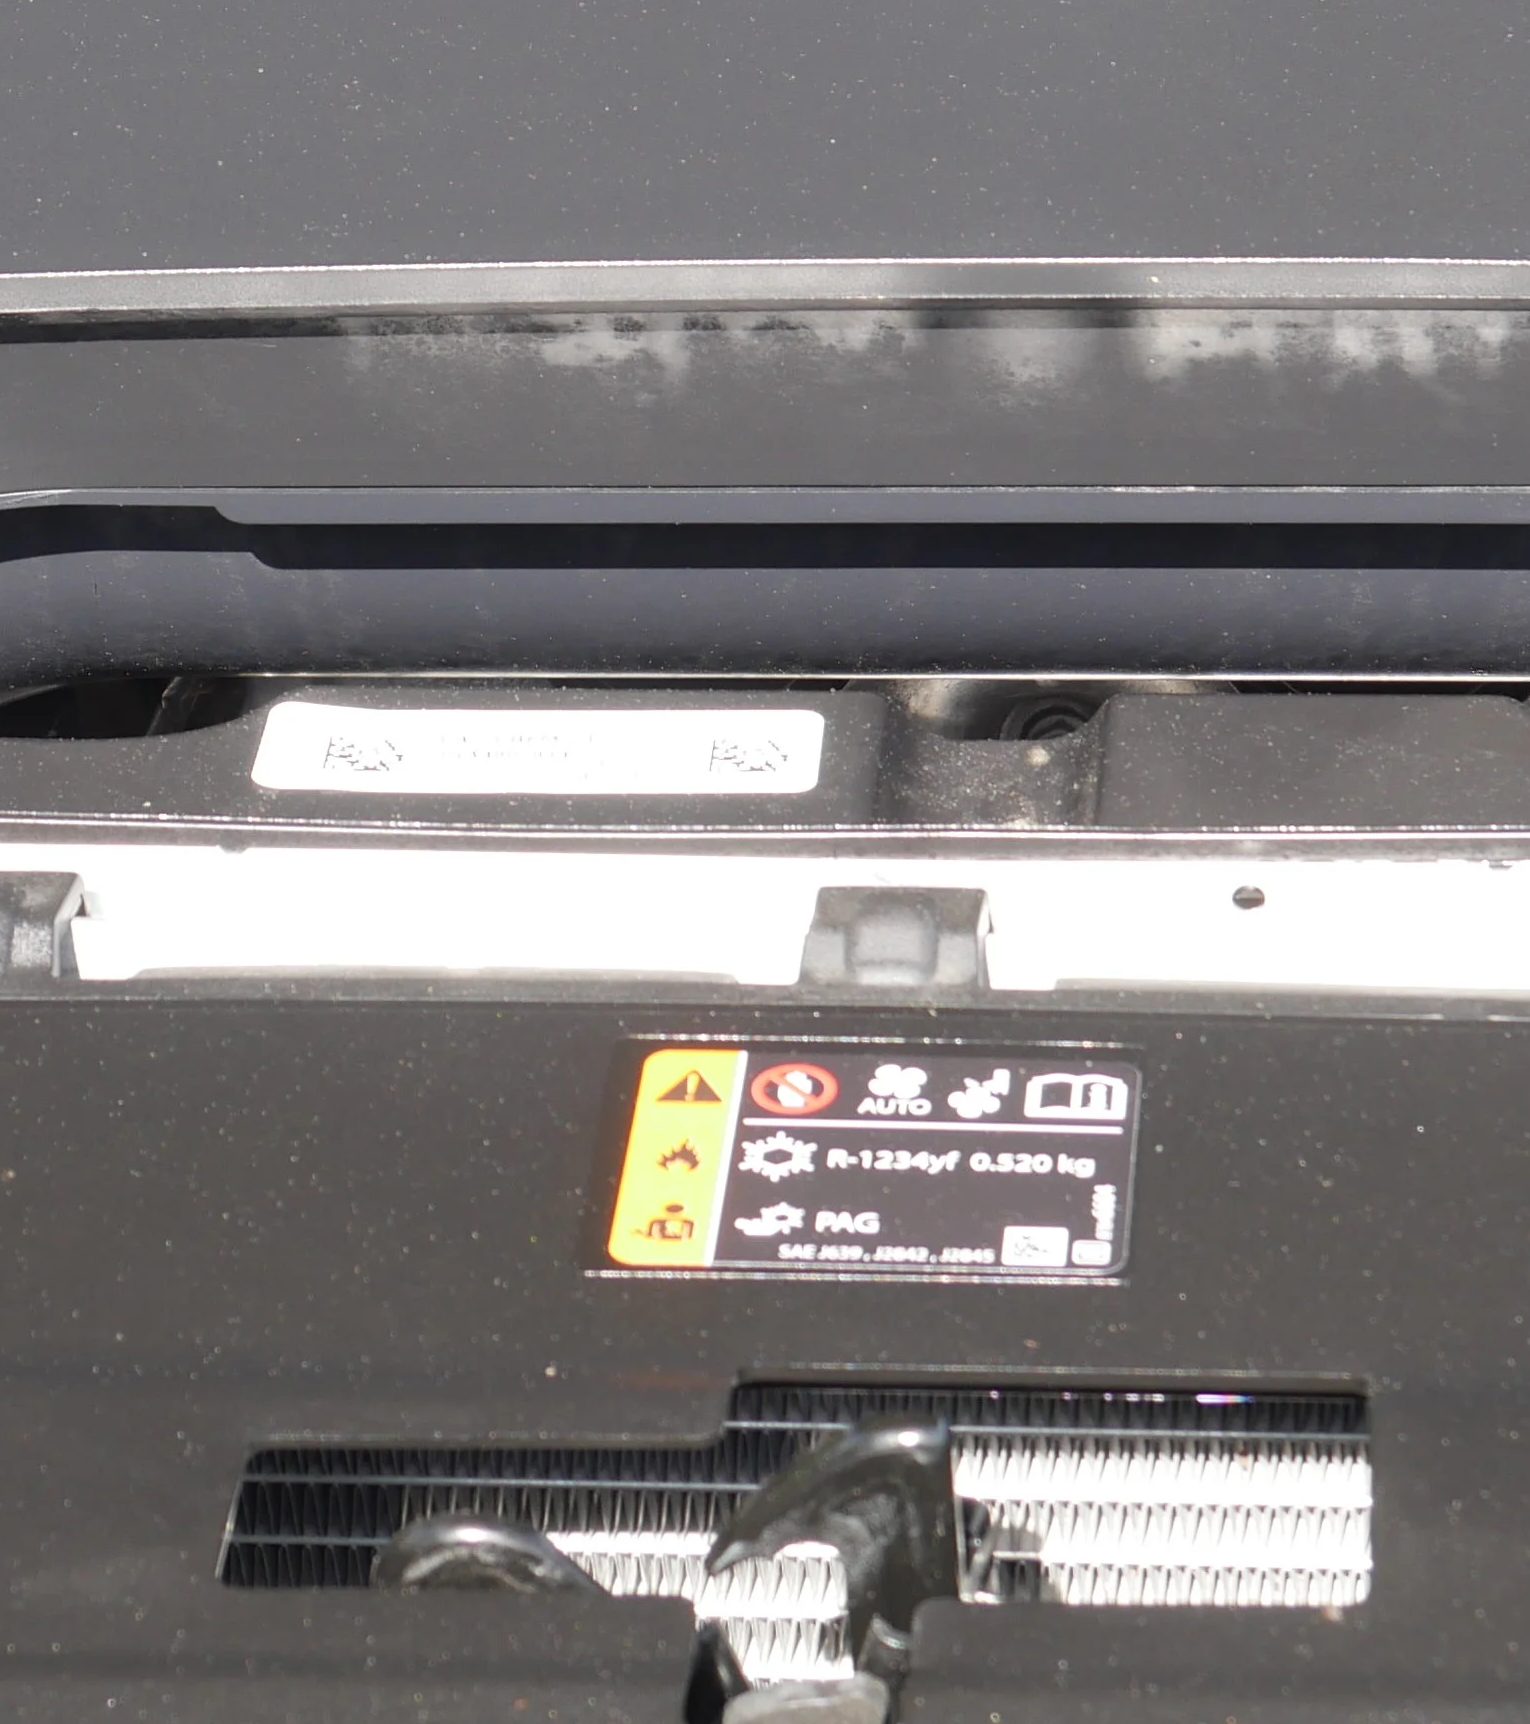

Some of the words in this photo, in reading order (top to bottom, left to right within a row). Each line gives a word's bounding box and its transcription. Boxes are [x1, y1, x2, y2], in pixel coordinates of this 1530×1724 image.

[857, 1098, 932, 1116] AUTO
[826, 1148, 960, 1175] R-1234yf
[969, 1152, 1053, 1173] 0.520
[1057, 1153, 1096, 1178] kg
[814, 1211, 881, 1235] PAG
[778, 1243, 816, 1260] SAE
